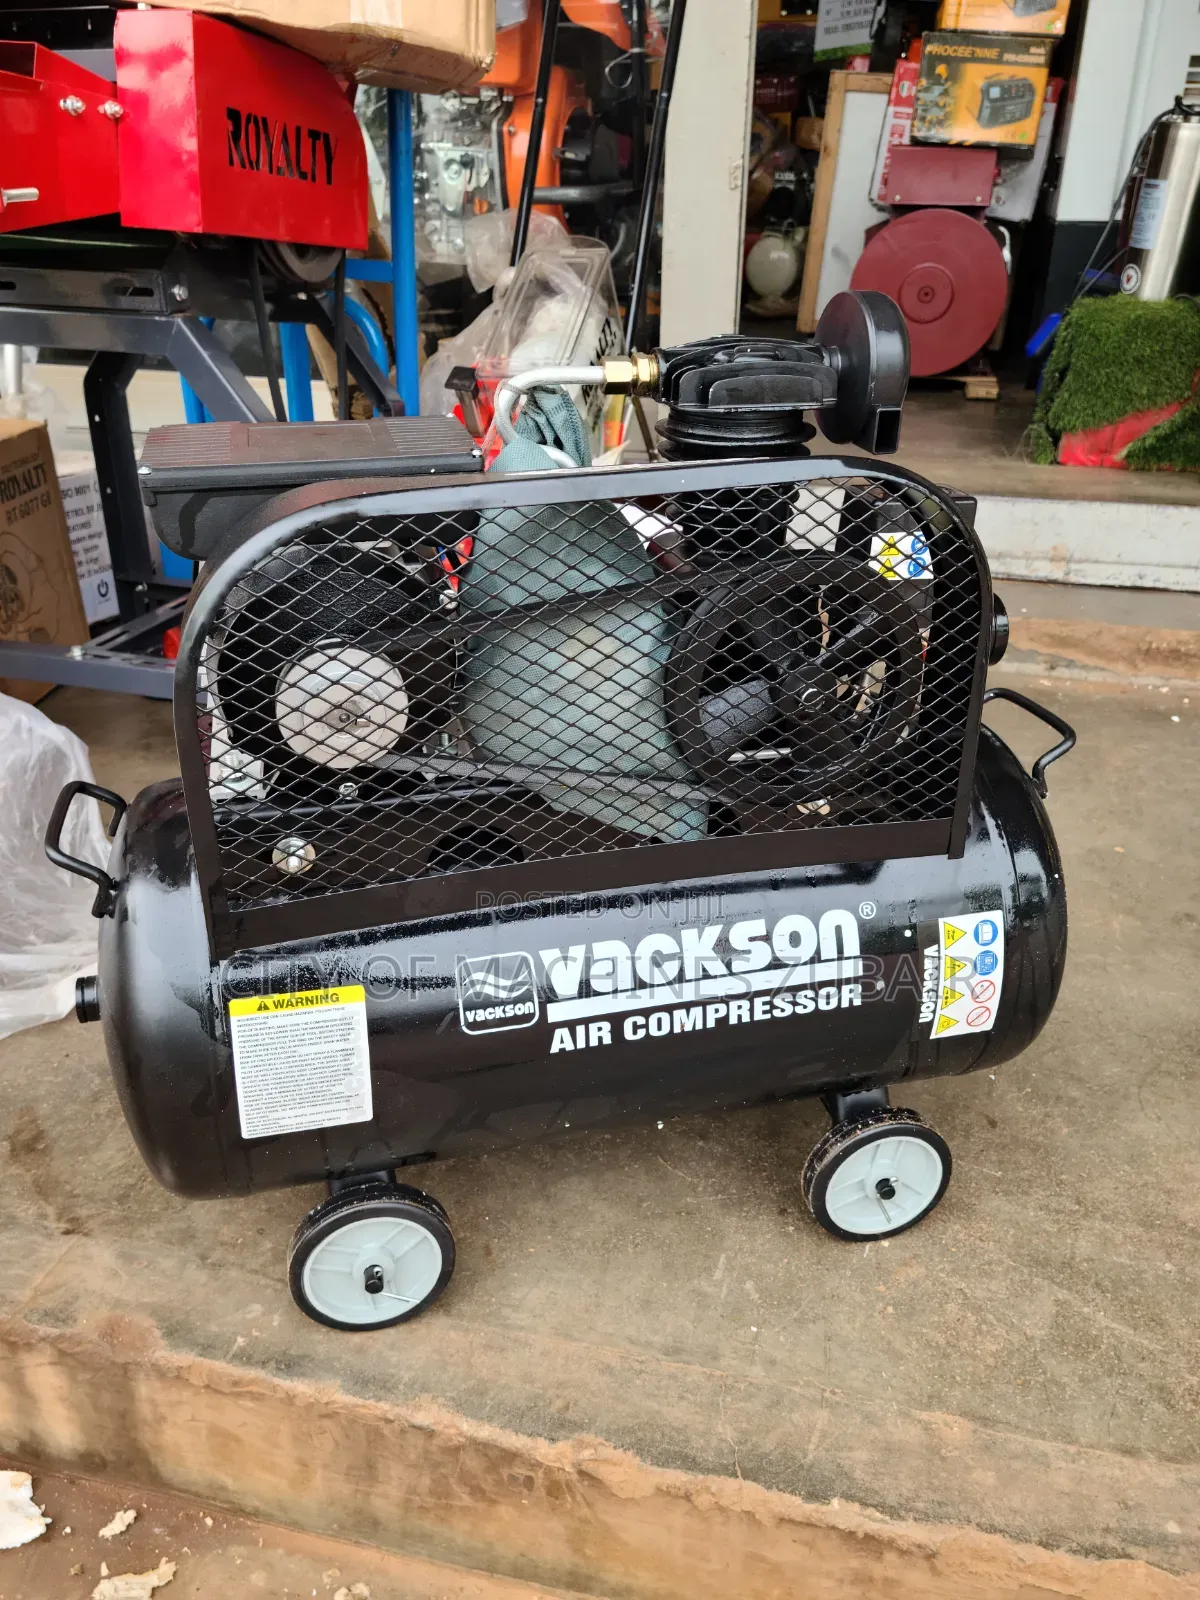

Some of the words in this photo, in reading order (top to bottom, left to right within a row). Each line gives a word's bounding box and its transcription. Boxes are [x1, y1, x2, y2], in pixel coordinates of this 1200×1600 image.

[226, 107, 338, 185] ROYALTY
[273, 992, 340, 1011] WARNING
[549, 1019, 612, 1054] AIR
[623, 983, 862, 1041] COMPRESSOR
